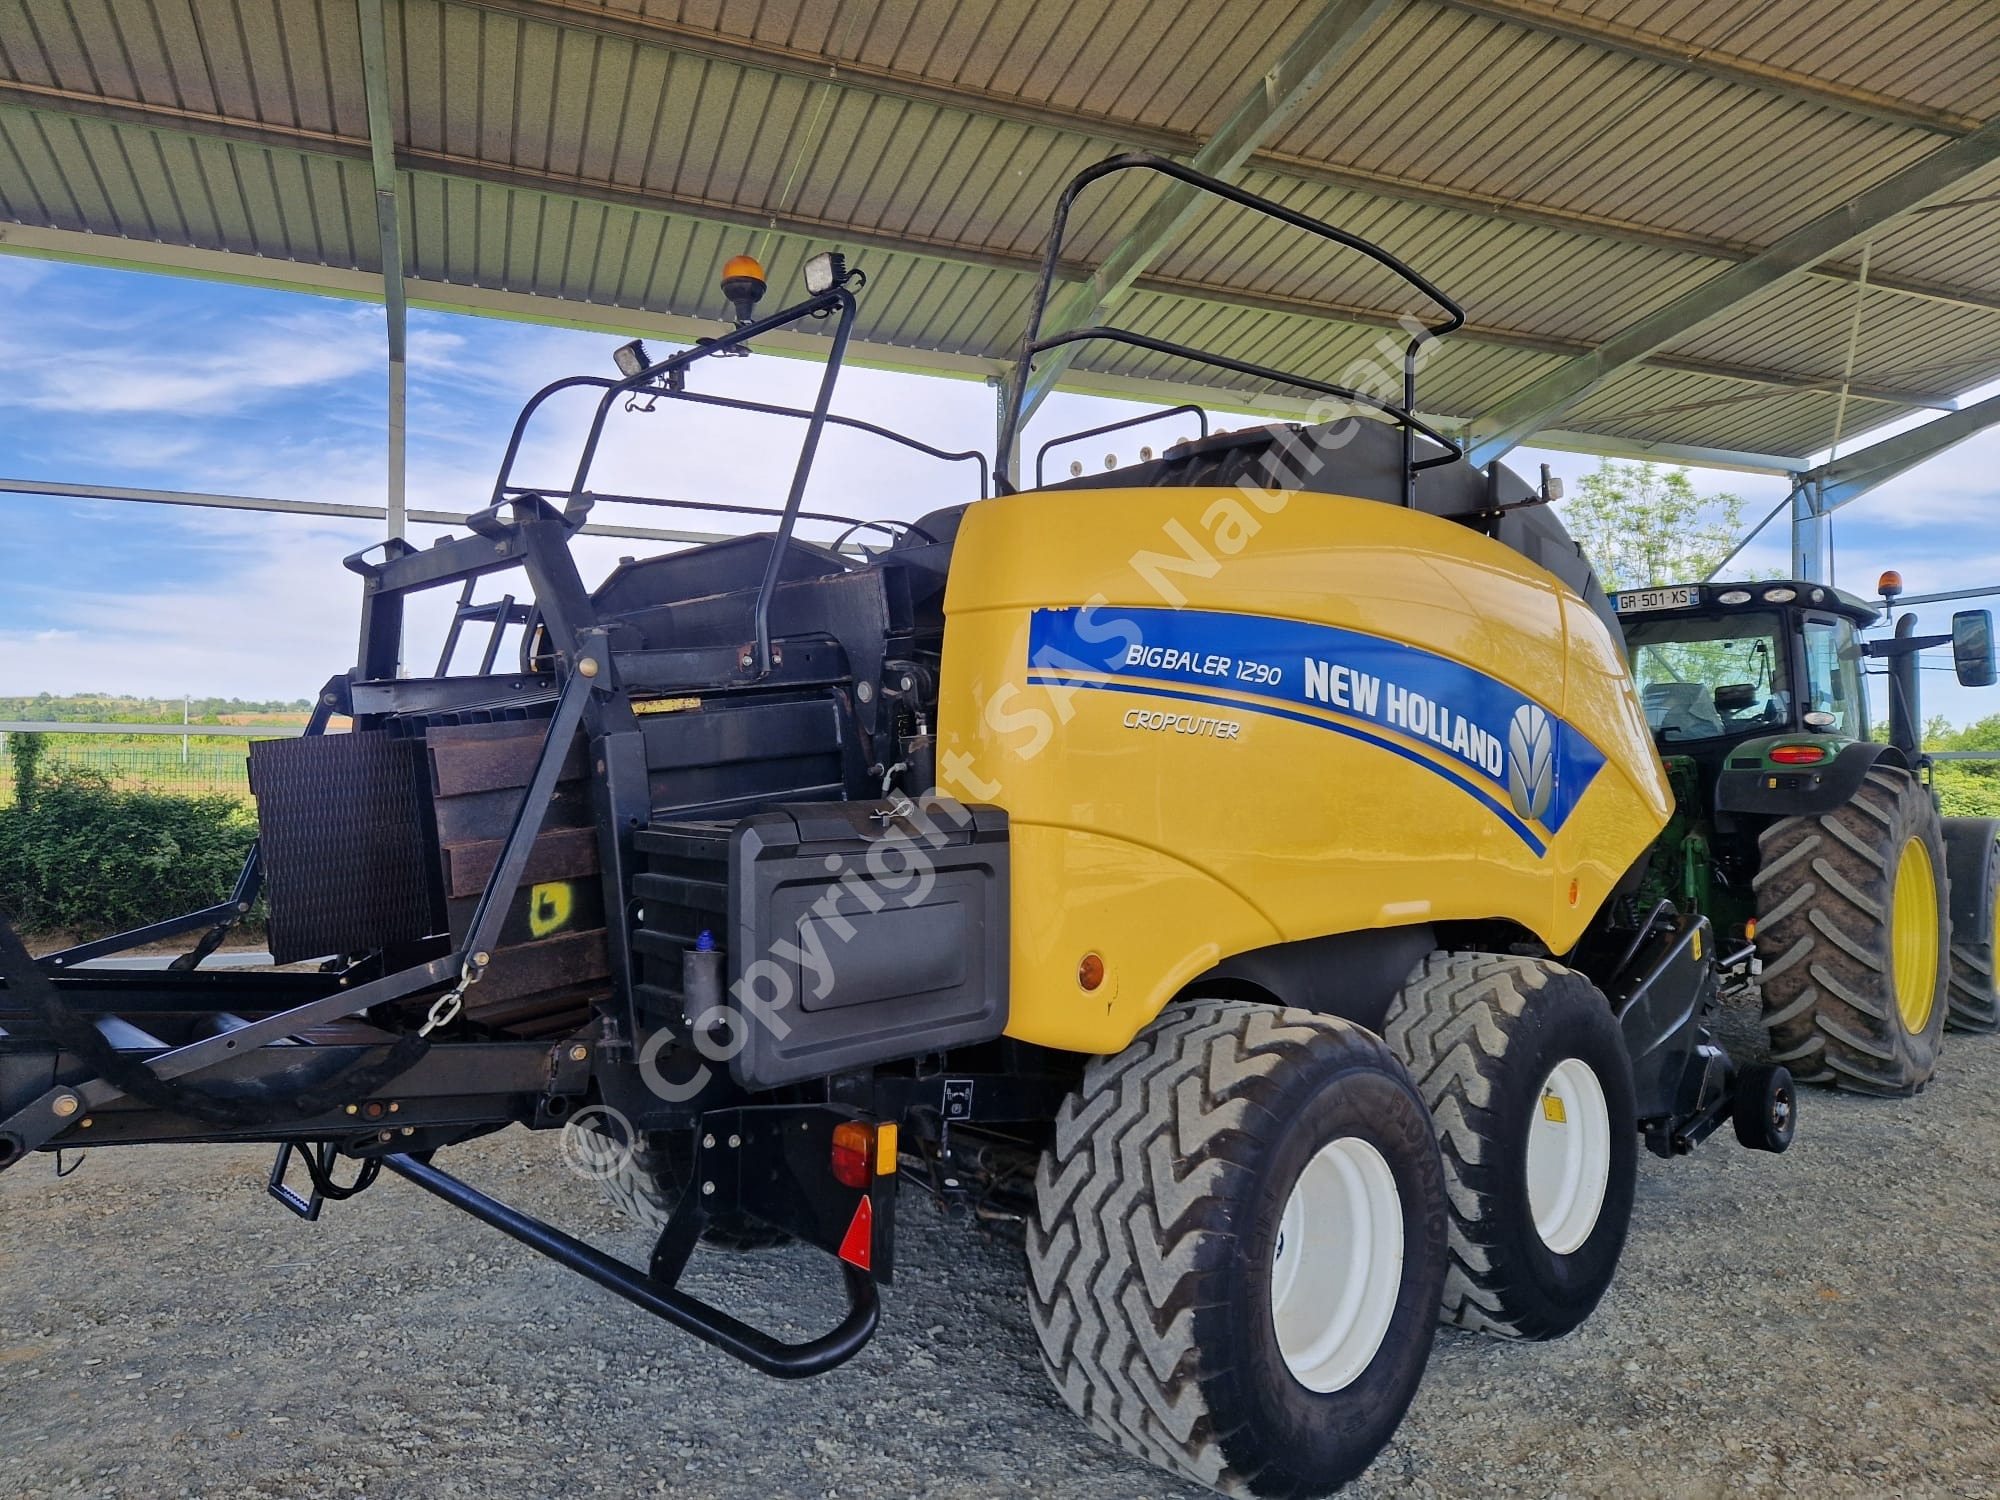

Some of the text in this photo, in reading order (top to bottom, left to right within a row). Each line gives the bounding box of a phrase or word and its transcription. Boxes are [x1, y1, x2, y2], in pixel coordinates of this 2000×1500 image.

[1620, 590, 1688, 609] GR-501-XS
[1125, 643, 1283, 687] BIGBALER 1290
[1122, 708, 1241, 741] CROPCUTTER
[1304, 656, 1503, 779] NEW HOLLAND
